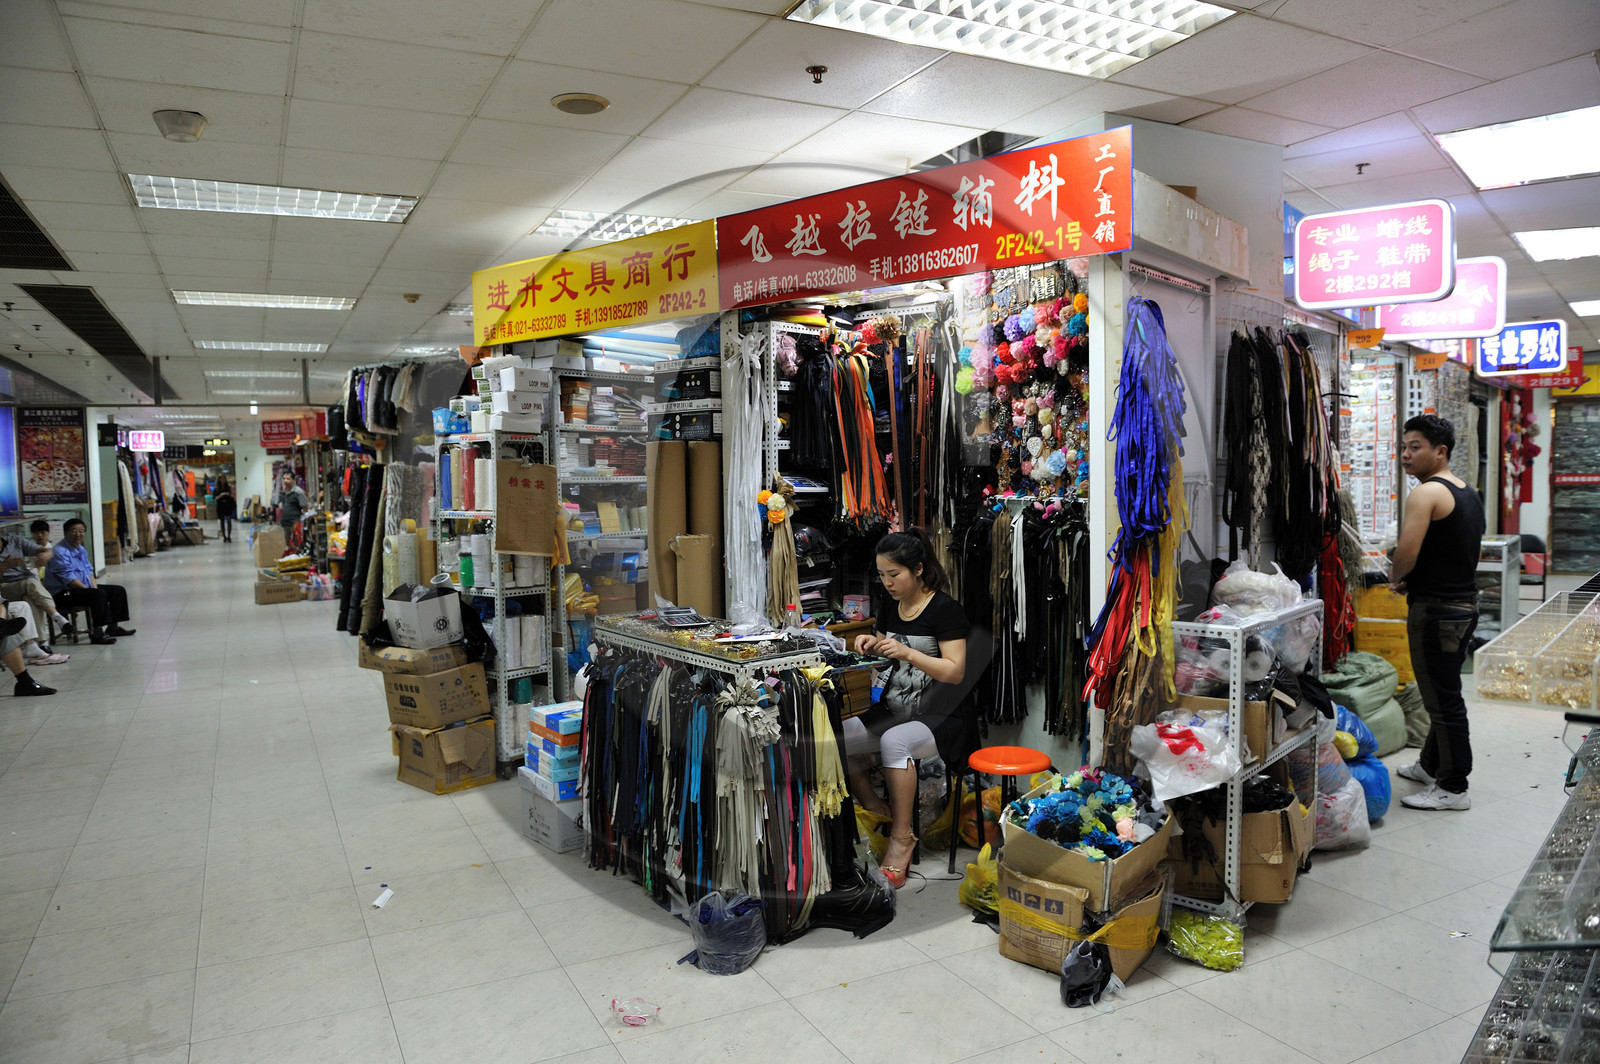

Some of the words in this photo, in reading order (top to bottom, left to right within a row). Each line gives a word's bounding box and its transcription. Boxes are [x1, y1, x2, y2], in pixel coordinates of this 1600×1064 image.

[740, 152, 1065, 263] 飞越拉链辅料
[1091, 143, 1117, 245] 工厂直销
[732, 264, 857, 303] 电话/传真:021-63332608
[868, 243, 979, 282] 手机:13816362607
[996, 220, 1083, 261] 2F242-1号
[1307, 223, 1361, 246] 专业
[1307, 249, 1360, 273] 绳子
[1375, 242, 1431, 267] 鞋带
[486, 242, 696, 312] 进升文具商行
[1325, 270, 1411, 294] 2楼292档
[483, 314, 567, 341] 电话/传真:021-63332789
[574, 300, 648, 329] 手机:13918522789
[659, 287, 707, 315] 2F242-2
[1355, 334, 1372, 344] 292
